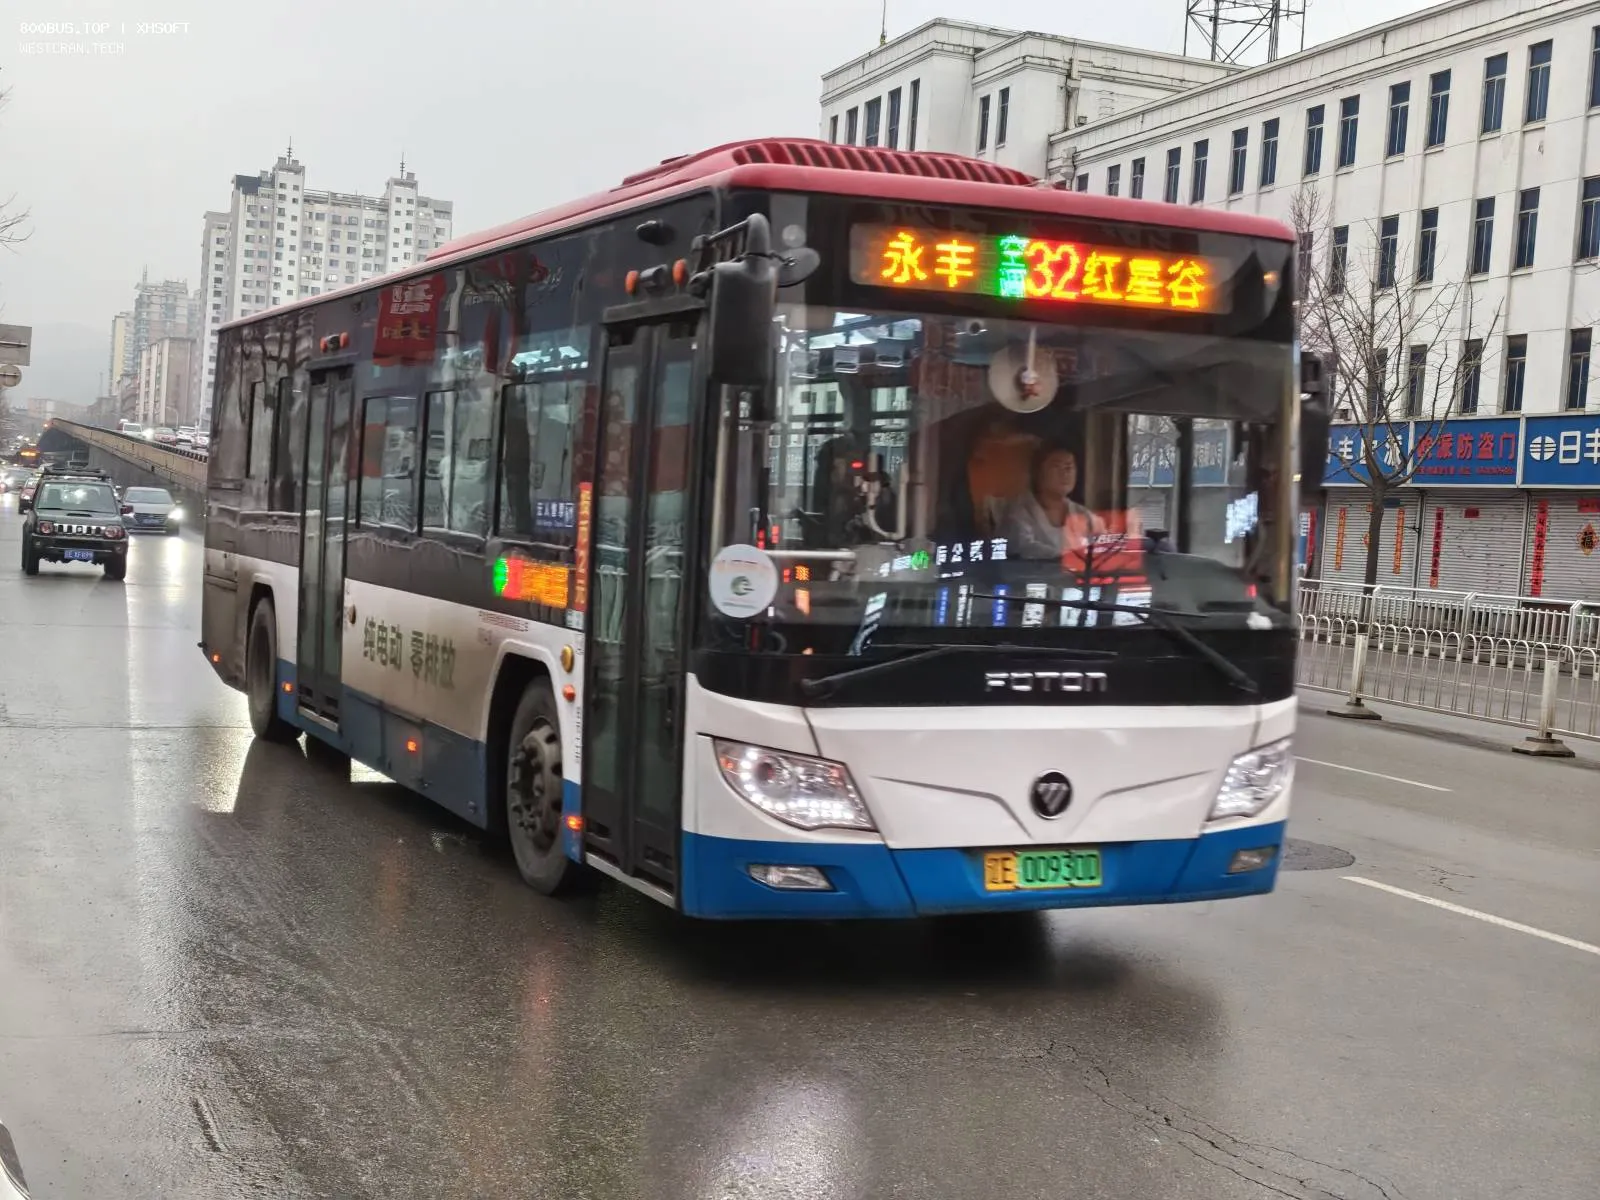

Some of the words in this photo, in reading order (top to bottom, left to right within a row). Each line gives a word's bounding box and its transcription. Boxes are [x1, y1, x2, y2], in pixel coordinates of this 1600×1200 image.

[880, 231, 975, 288] 永丰
[1025, 242, 1080, 299] 32
[1081, 252, 1206, 308] 红星谷
[363, 616, 402, 672] 纯电动
[985, 671, 1107, 692] FOTON
